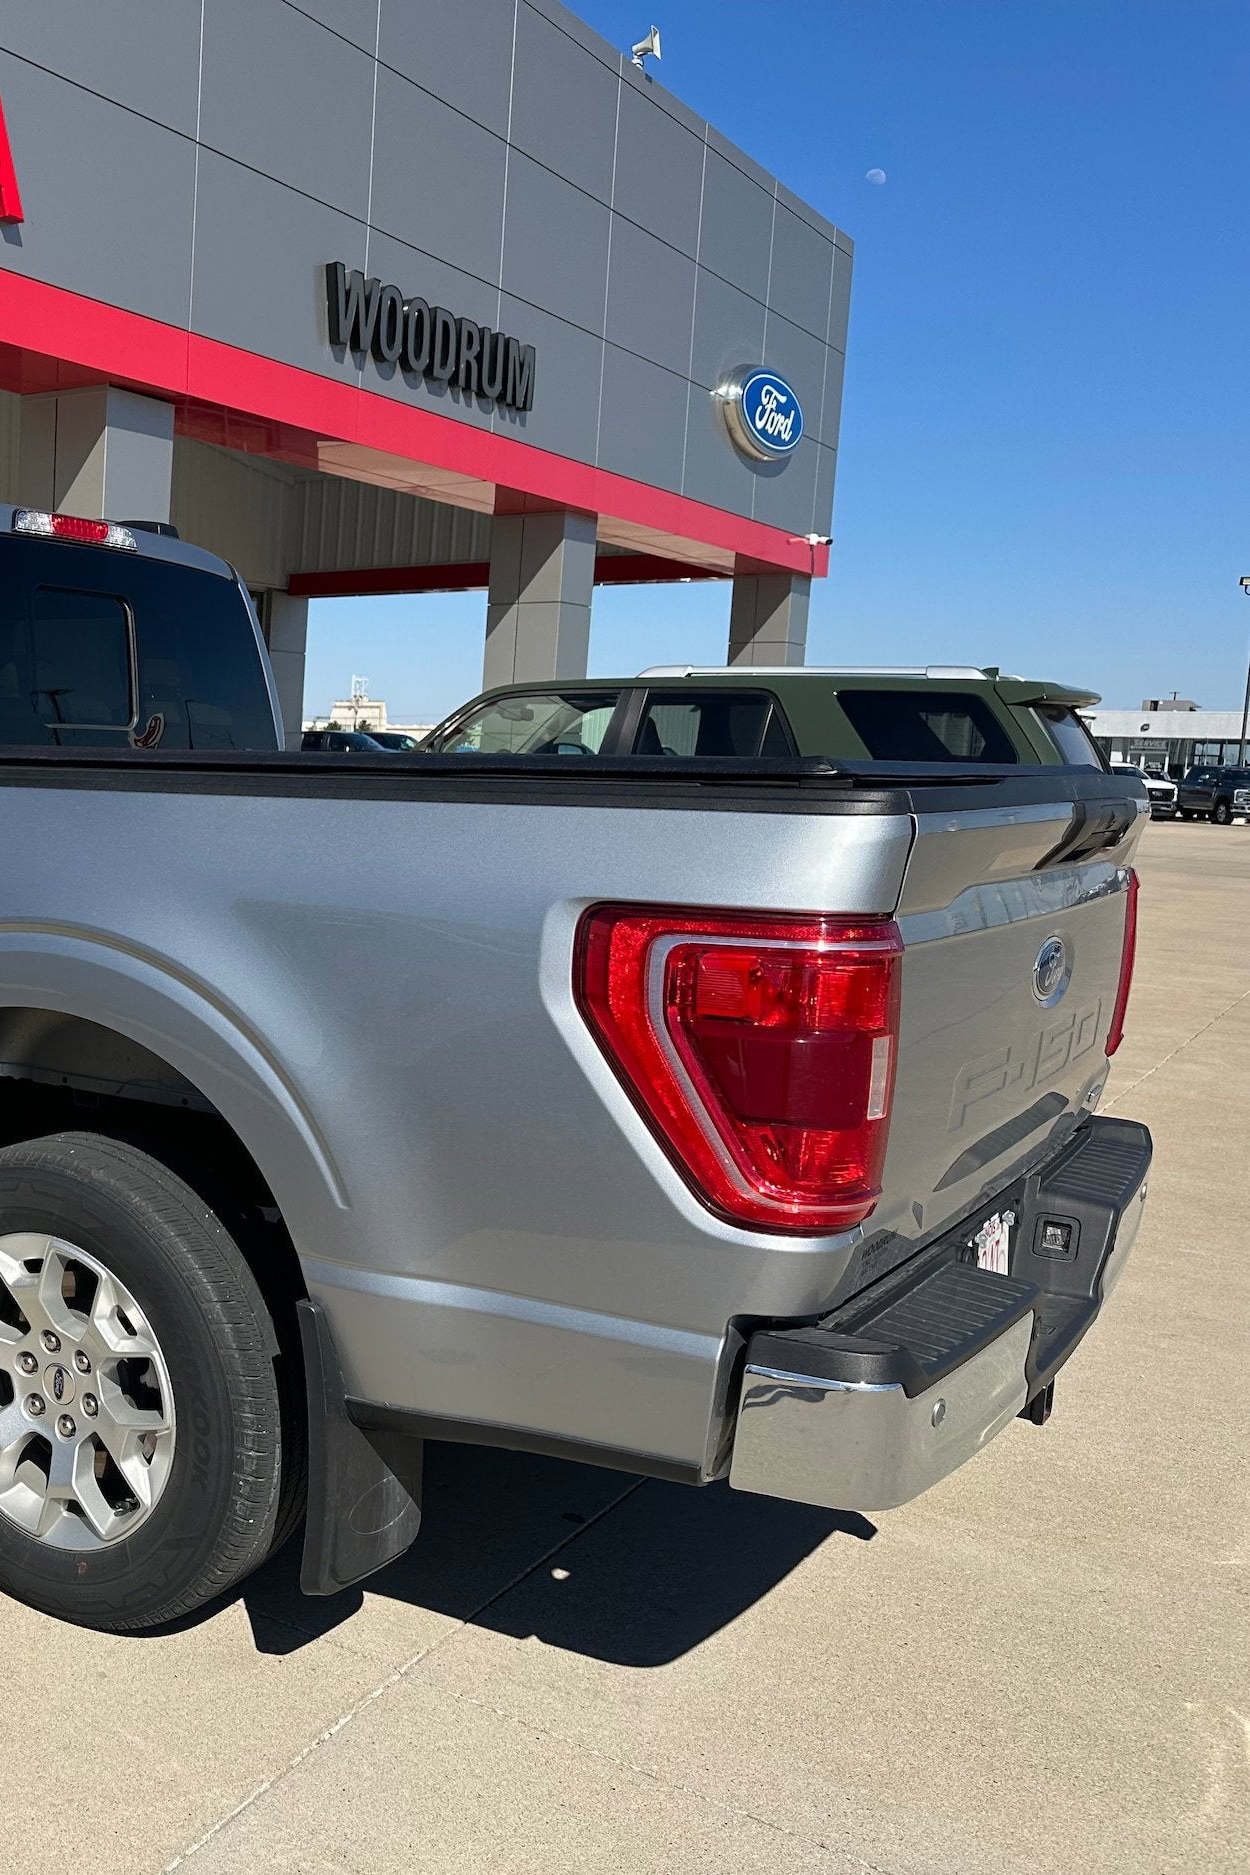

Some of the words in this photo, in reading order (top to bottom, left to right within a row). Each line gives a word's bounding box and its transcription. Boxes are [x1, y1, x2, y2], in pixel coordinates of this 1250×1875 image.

[326, 261, 535, 411] WOODRUM
[755, 384, 795, 441] Ford
[947, 998, 1102, 1132] F-150
